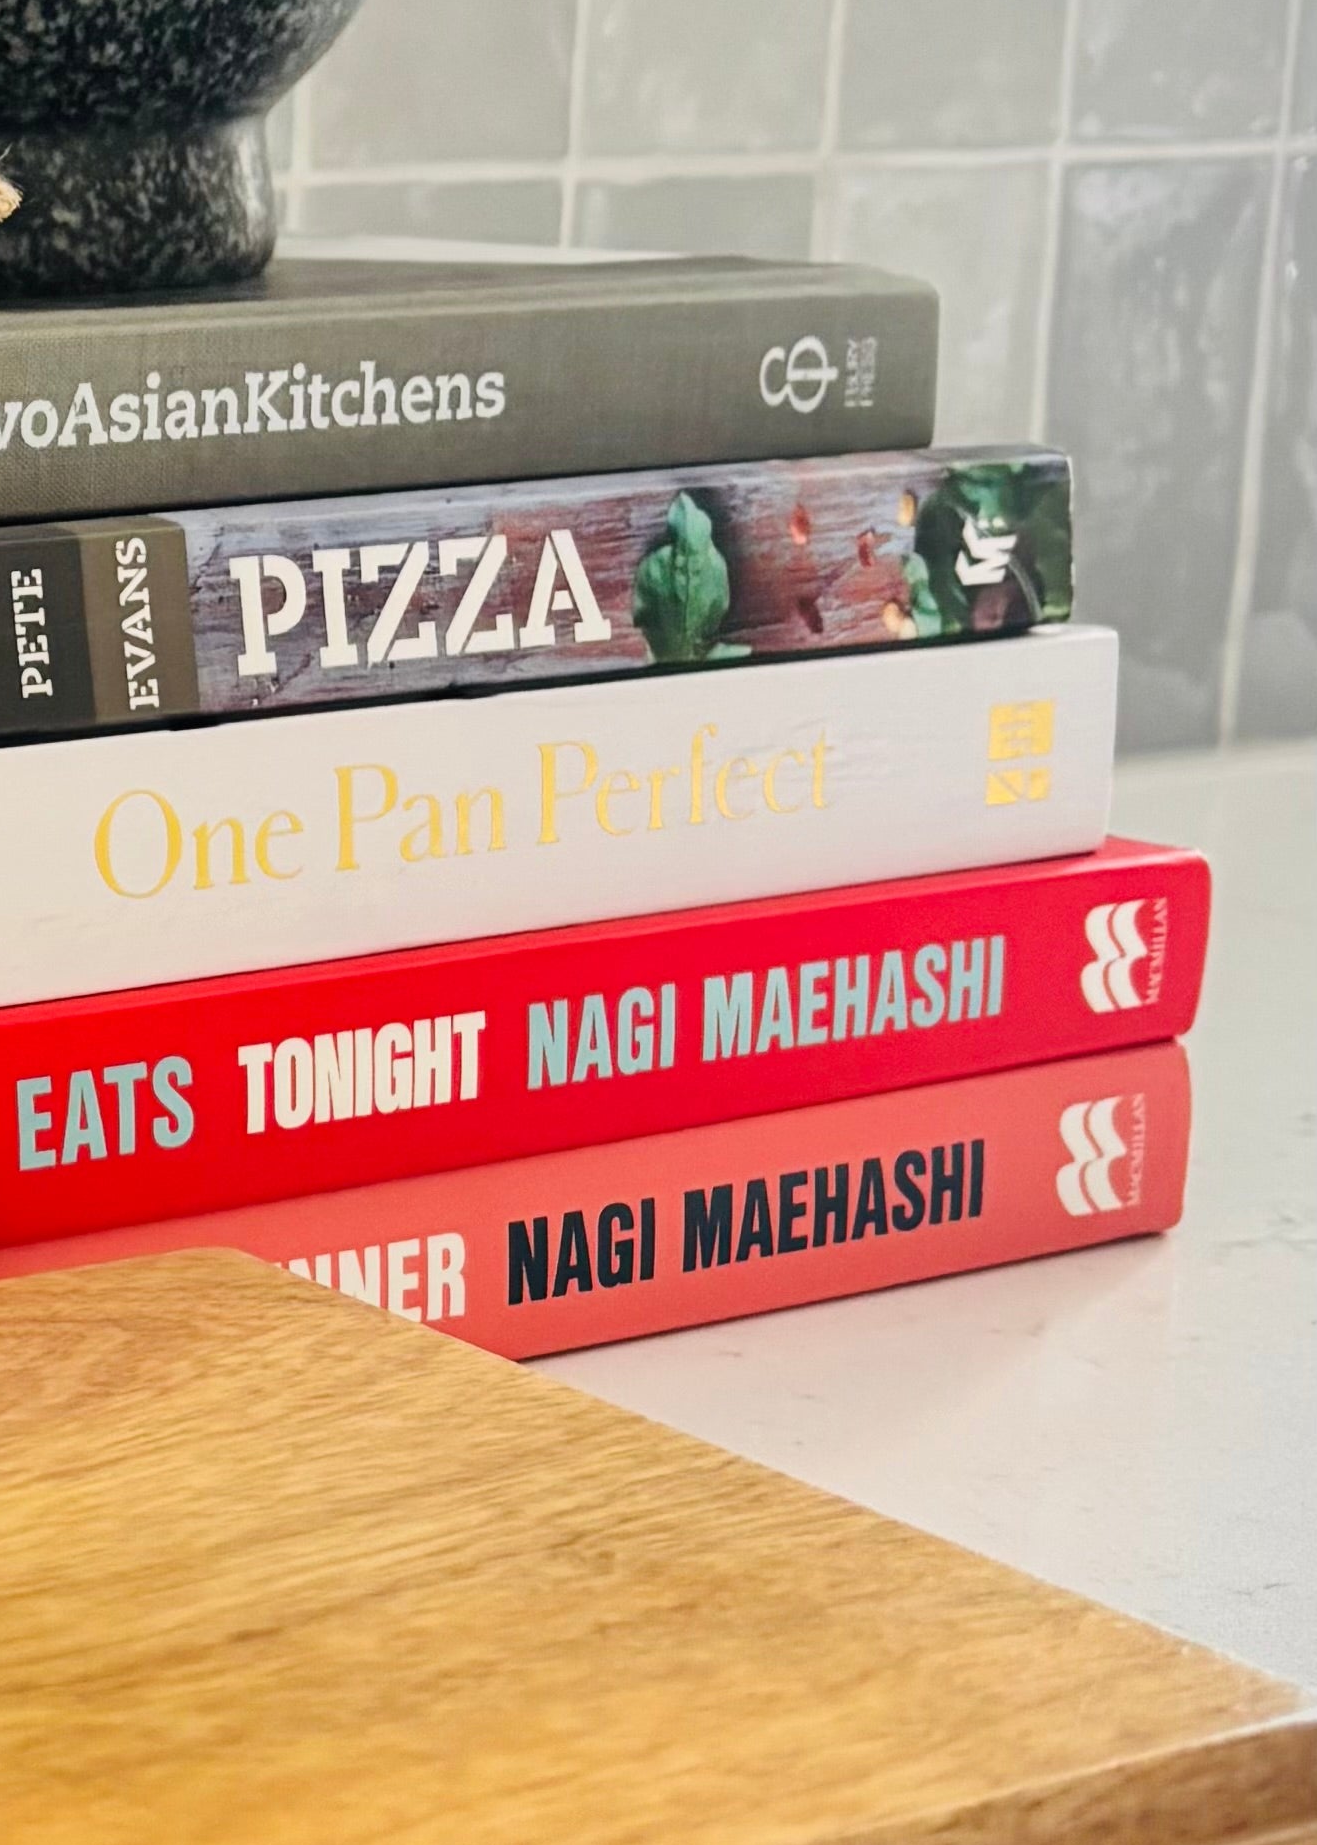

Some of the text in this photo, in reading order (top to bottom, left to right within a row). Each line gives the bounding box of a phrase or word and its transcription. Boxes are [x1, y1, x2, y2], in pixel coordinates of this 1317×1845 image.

[10, 568, 53, 698] PETE
[115, 537, 160, 710] EVANS
[229, 528, 611, 677] PIZZA
[94, 722, 838, 900] One Pan Perfect
[16, 1054, 196, 1171] EATS
[238, 1010, 487, 1136] TONIGHT
[526, 980, 676, 1091] NAGI
[701, 934, 1005, 1062] MAEHASHI
[506, 1197, 657, 1307] NAGI
[682, 1138, 985, 1273] MAEHASHI
